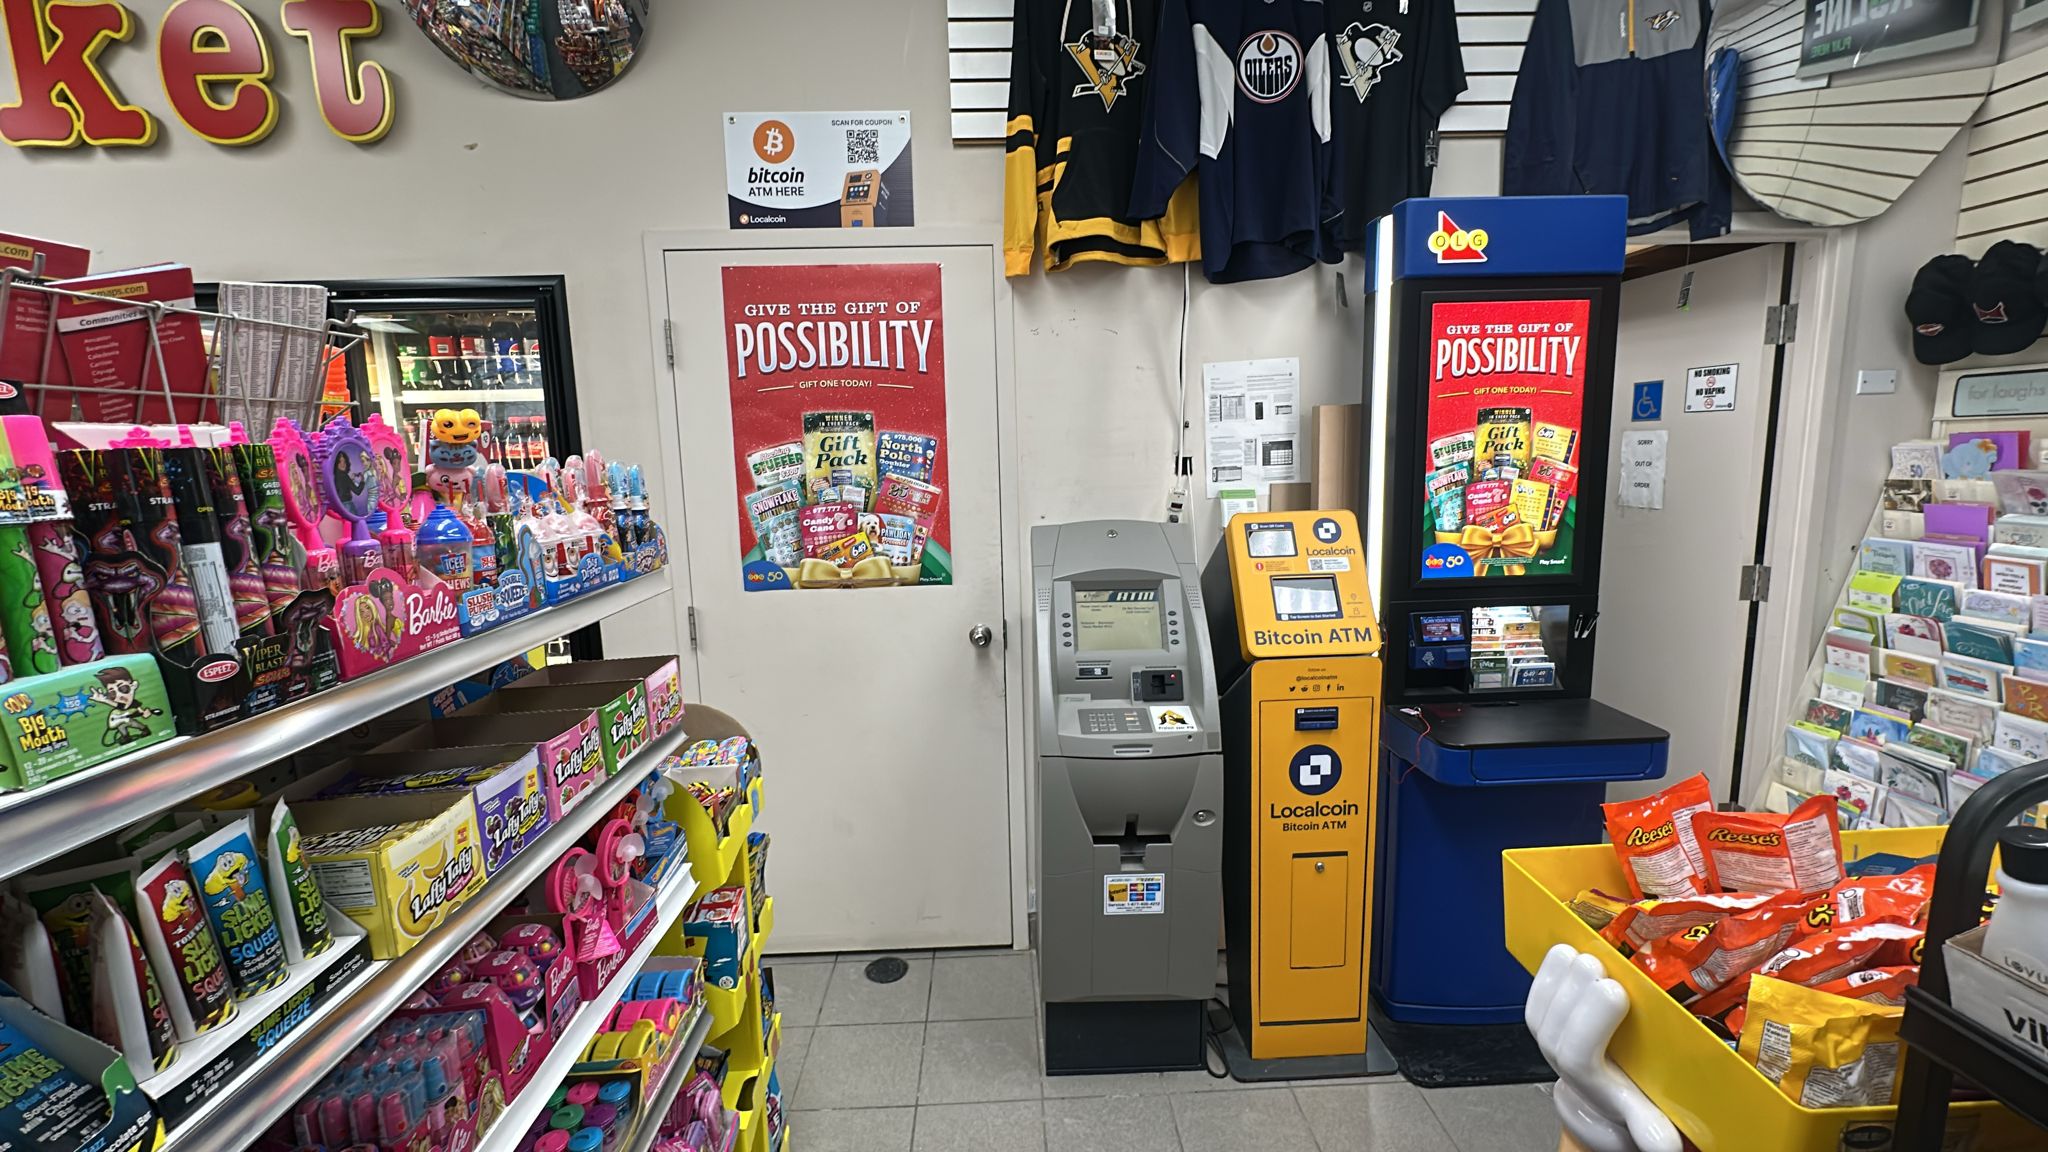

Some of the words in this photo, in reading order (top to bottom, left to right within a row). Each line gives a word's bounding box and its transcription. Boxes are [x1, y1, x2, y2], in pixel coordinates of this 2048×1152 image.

[0, 0, 394, 147] ket
[1244, 55, 1292, 96] OILERS
[748, 167, 805, 184] bitcoin
[748, 187, 773, 197] ATM
[776, 186, 805, 196] HERE
[750, 215, 786, 224] Localcoin
[1435, 234, 1483, 247] OLG
[744, 304, 790, 316] GIVE
[799, 303, 836, 315] THE
[844, 302, 888, 315] GIFT
[895, 302, 920, 314] OF
[80, 311, 138, 327] Communities
[1446, 325, 1480, 335] GIVE
[1485, 324, 1513, 334] THE
[1518, 324, 1550, 333] GIFT
[1554, 323, 1574, 332] OF
[734, 319, 934, 378] POSSIBILITY
[1436, 336, 1581, 381] POSSIBILITY
[1694, 370, 1702, 378] NO
[1704, 367, 1731, 377] SMOKING
[799, 380, 819, 389] GIFT
[820, 380, 839, 388] ONE
[840, 379, 873, 388] TODAY!
[1474, 387, 1491, 395] GIFT
[1492, 387, 1509, 395] ONE
[1510, 386, 1537, 395] TODAY!
[1696, 388, 1703, 396] NO
[1704, 386, 1726, 396] VAPING
[1967, 385, 1986, 401] for
[1993, 381, 2046, 402] laughs
[1488, 426, 1519, 440] Gift
[820, 435, 861, 453] Gift
[881, 440, 923, 454] North
[1434, 440, 1475, 459] STUFFER
[1483, 438, 1524, 453] Pack
[752, 452, 805, 475] STUFFER
[815, 450, 868, 470] Pack
[880, 449, 912, 462] Pole
[880, 458, 911, 469] Doubler
[751, 489, 799, 516] SNOWFLAKE
[803, 516, 835, 527] Candy
[810, 524, 835, 533] Cane
[1306, 546, 1356, 557] Localcoin
[445, 556, 466, 572] ICEE
[1446, 556, 1464, 568] 50
[501, 574, 522, 587] DOUBLE
[767, 572, 784, 582] 50
[467, 592, 494, 607] SLUSH
[1116, 591, 1154, 601] ATM
[406, 591, 458, 636] Barbie
[468, 602, 495, 619] PUPPIE
[1254, 629, 1323, 646] Bitcoin
[1329, 628, 1373, 643] ATM
[203, 664, 232, 678] ESPEEZ
[242, 644, 283, 680] VIPER
[256, 657, 285, 673] BLAST
[18, 714, 47, 737] Big
[610, 713, 633, 744] Laffy
[631, 697, 647, 726] Taffy
[19, 727, 67, 752] Mouth
[554, 747, 583, 787] Laffy
[582, 726, 600, 759] Taffy
[1270, 800, 1359, 819] Localcoin
[492, 815, 520, 849] Laffy
[519, 791, 540, 822] Taffy
[1282, 822, 1320, 832] Bitcoin
[1322, 821, 1347, 830] ATM
[1626, 820, 1674, 847] Reese's
[1708, 828, 1781, 847] Reese's
[411, 876, 447, 923] Laffy
[445, 847, 473, 885] Taffy
[220, 888, 268, 929] SLIME
[222, 904, 275, 948] LICKER
[240, 953, 276, 978] Bonbons
[243, 953, 266, 969] Sour
[328, 967, 344, 983] Sour
[343, 954, 362, 972] Candy
[596, 948, 627, 991] Barbie
[550, 956, 574, 998] Barbie
[250, 1007, 283, 1042] SLIME
[282, 982, 317, 1014] LICKER
[256, 996, 313, 1057] SQUEEZE
[16, 1093, 44, 1111] Blue
[40, 1078, 67, 1095] Razz
[22, 1082, 79, 1121] Sour-Filled
[19, 1116, 47, 1135] Milk
[44, 1084, 93, 1117] Chocolate
[56, 1104, 78, 1119] Bar
[136, 1110, 153, 1127] Bar
